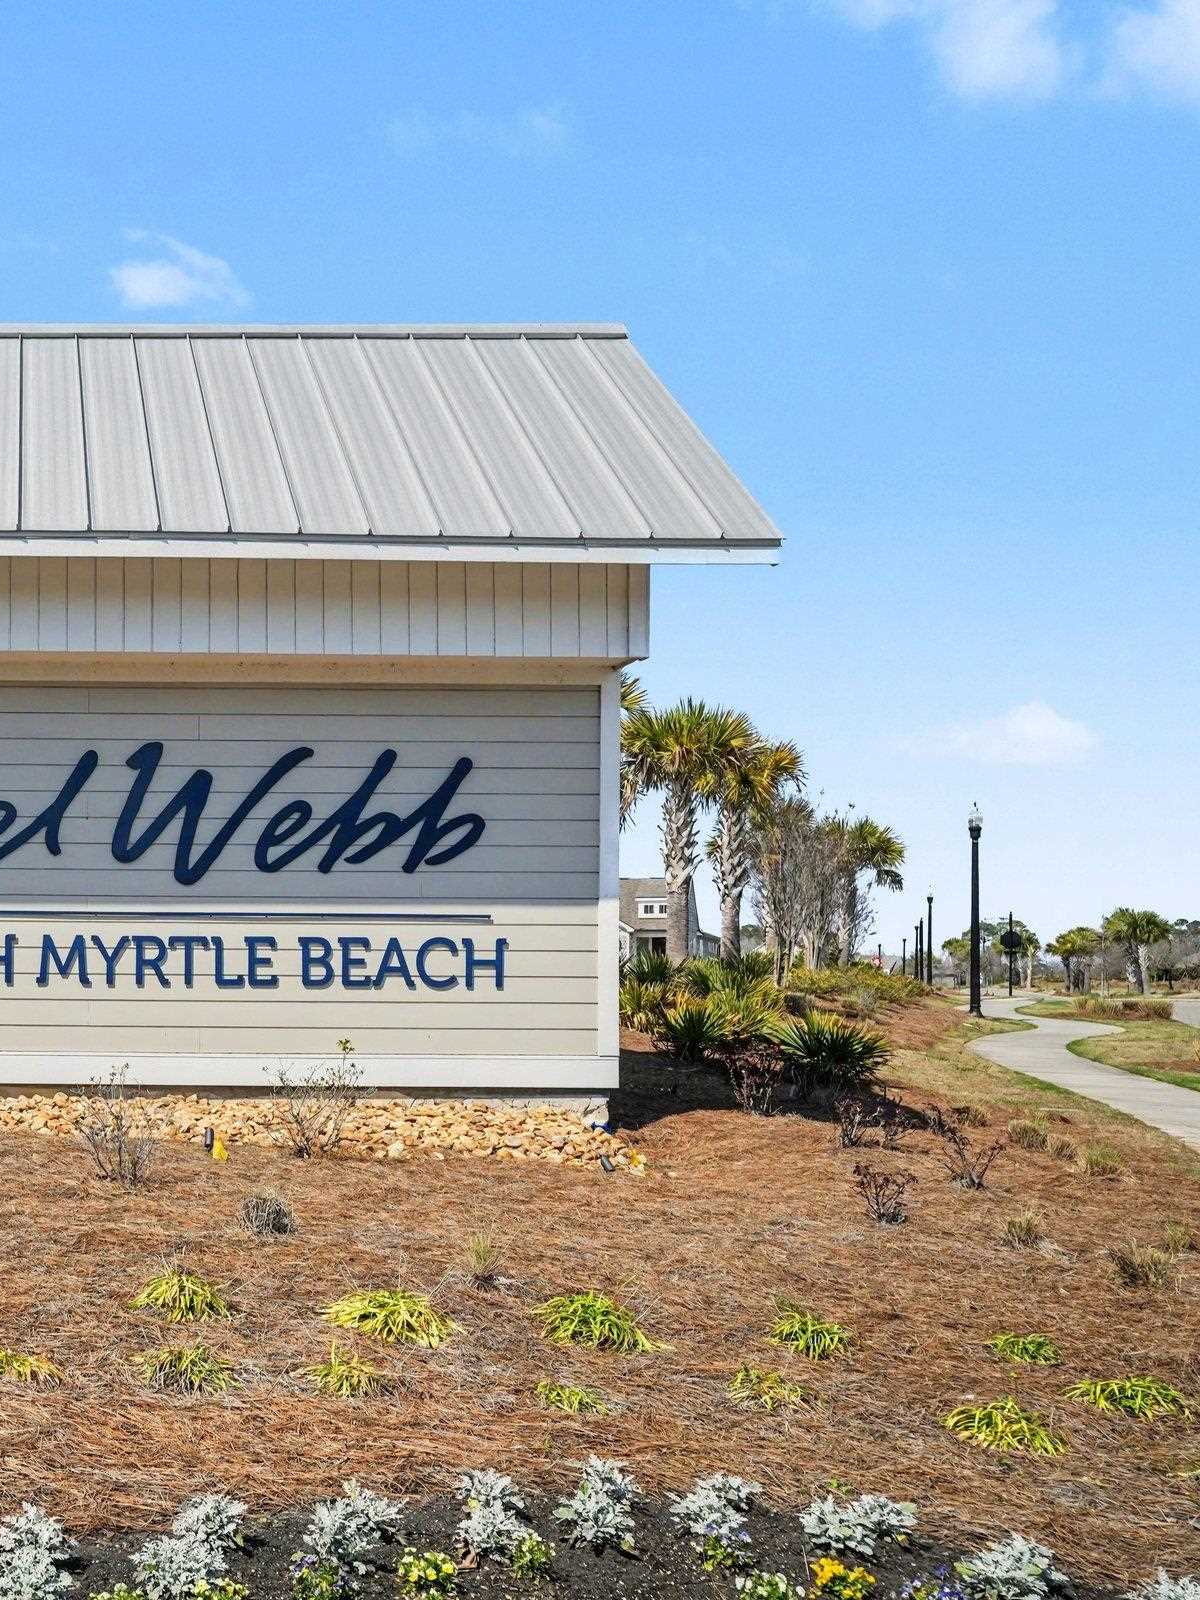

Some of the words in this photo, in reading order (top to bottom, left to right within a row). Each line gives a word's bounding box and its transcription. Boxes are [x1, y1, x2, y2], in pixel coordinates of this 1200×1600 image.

[111, 742, 487, 886] Webb
[36, 935, 280, 989] MYRTLE
[300, 937, 508, 990] BEACH
